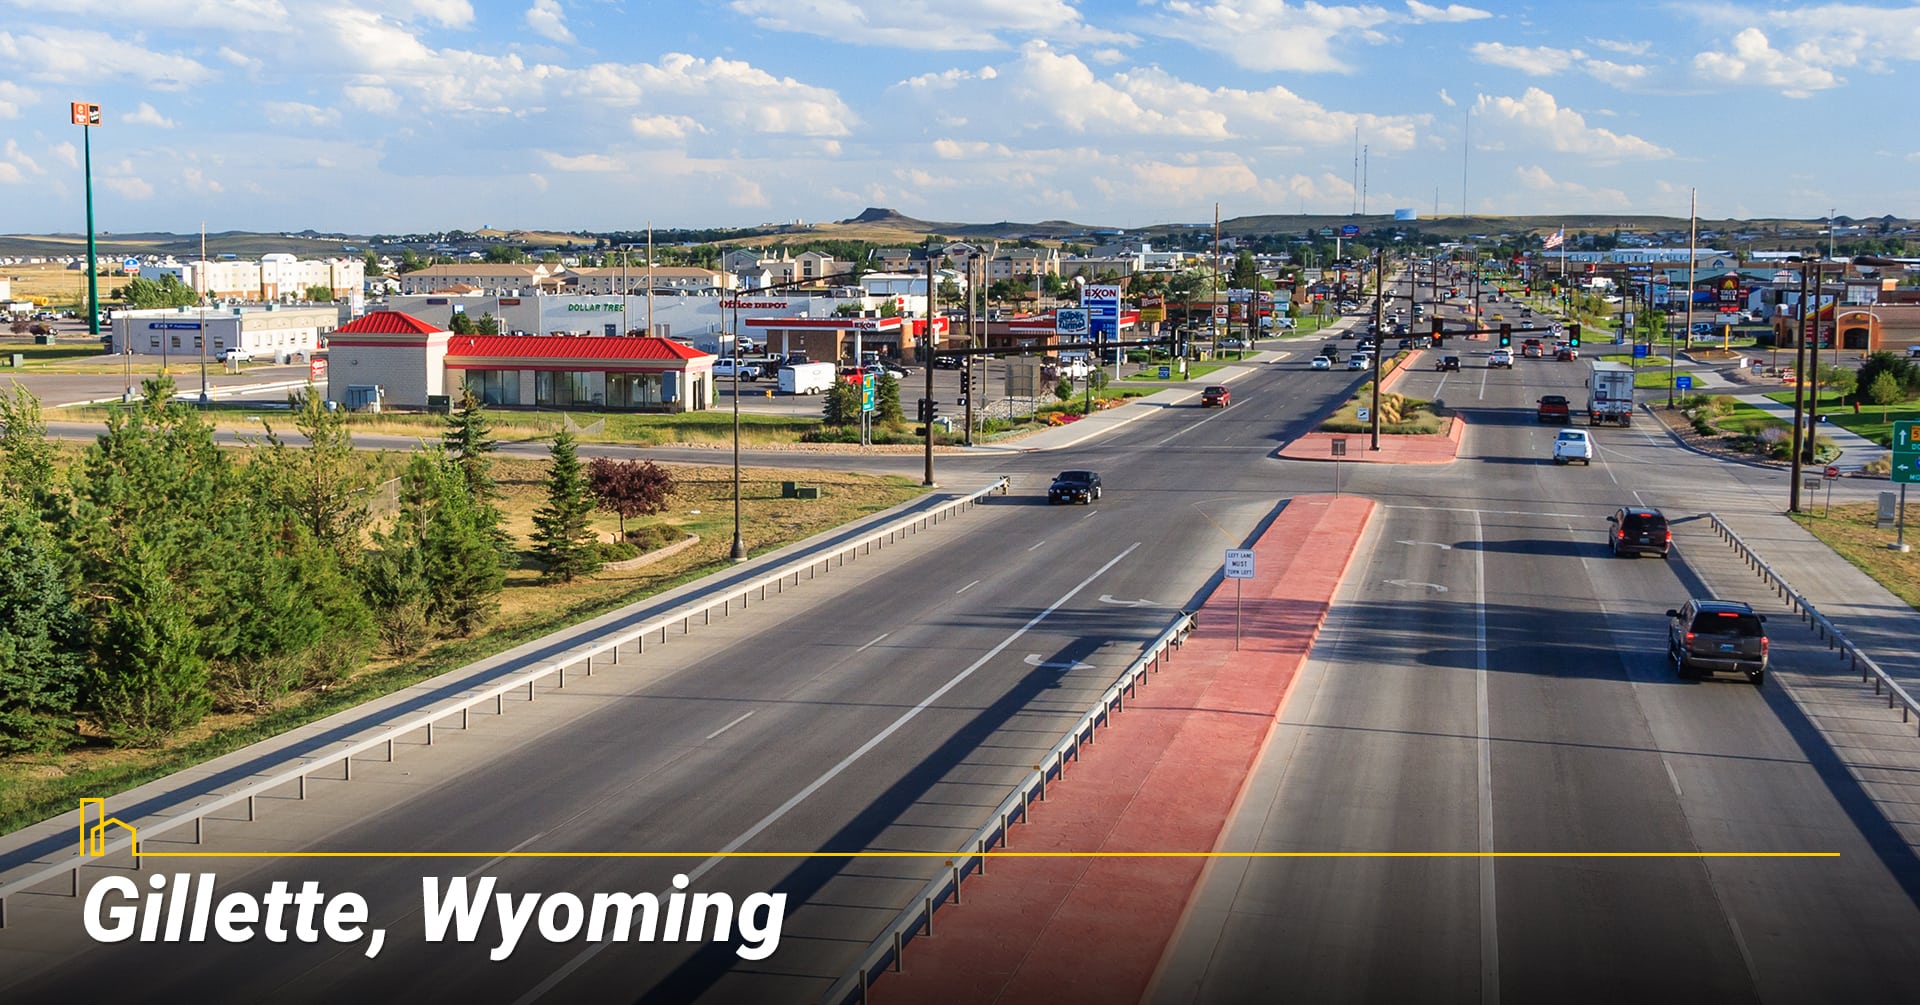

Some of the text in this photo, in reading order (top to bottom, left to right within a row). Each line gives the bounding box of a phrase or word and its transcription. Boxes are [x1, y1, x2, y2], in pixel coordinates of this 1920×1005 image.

[1085, 288, 1117, 300] EXXON
[568, 303, 625, 312] DOLLAR TREE
[854, 321, 876, 330] EXXON
